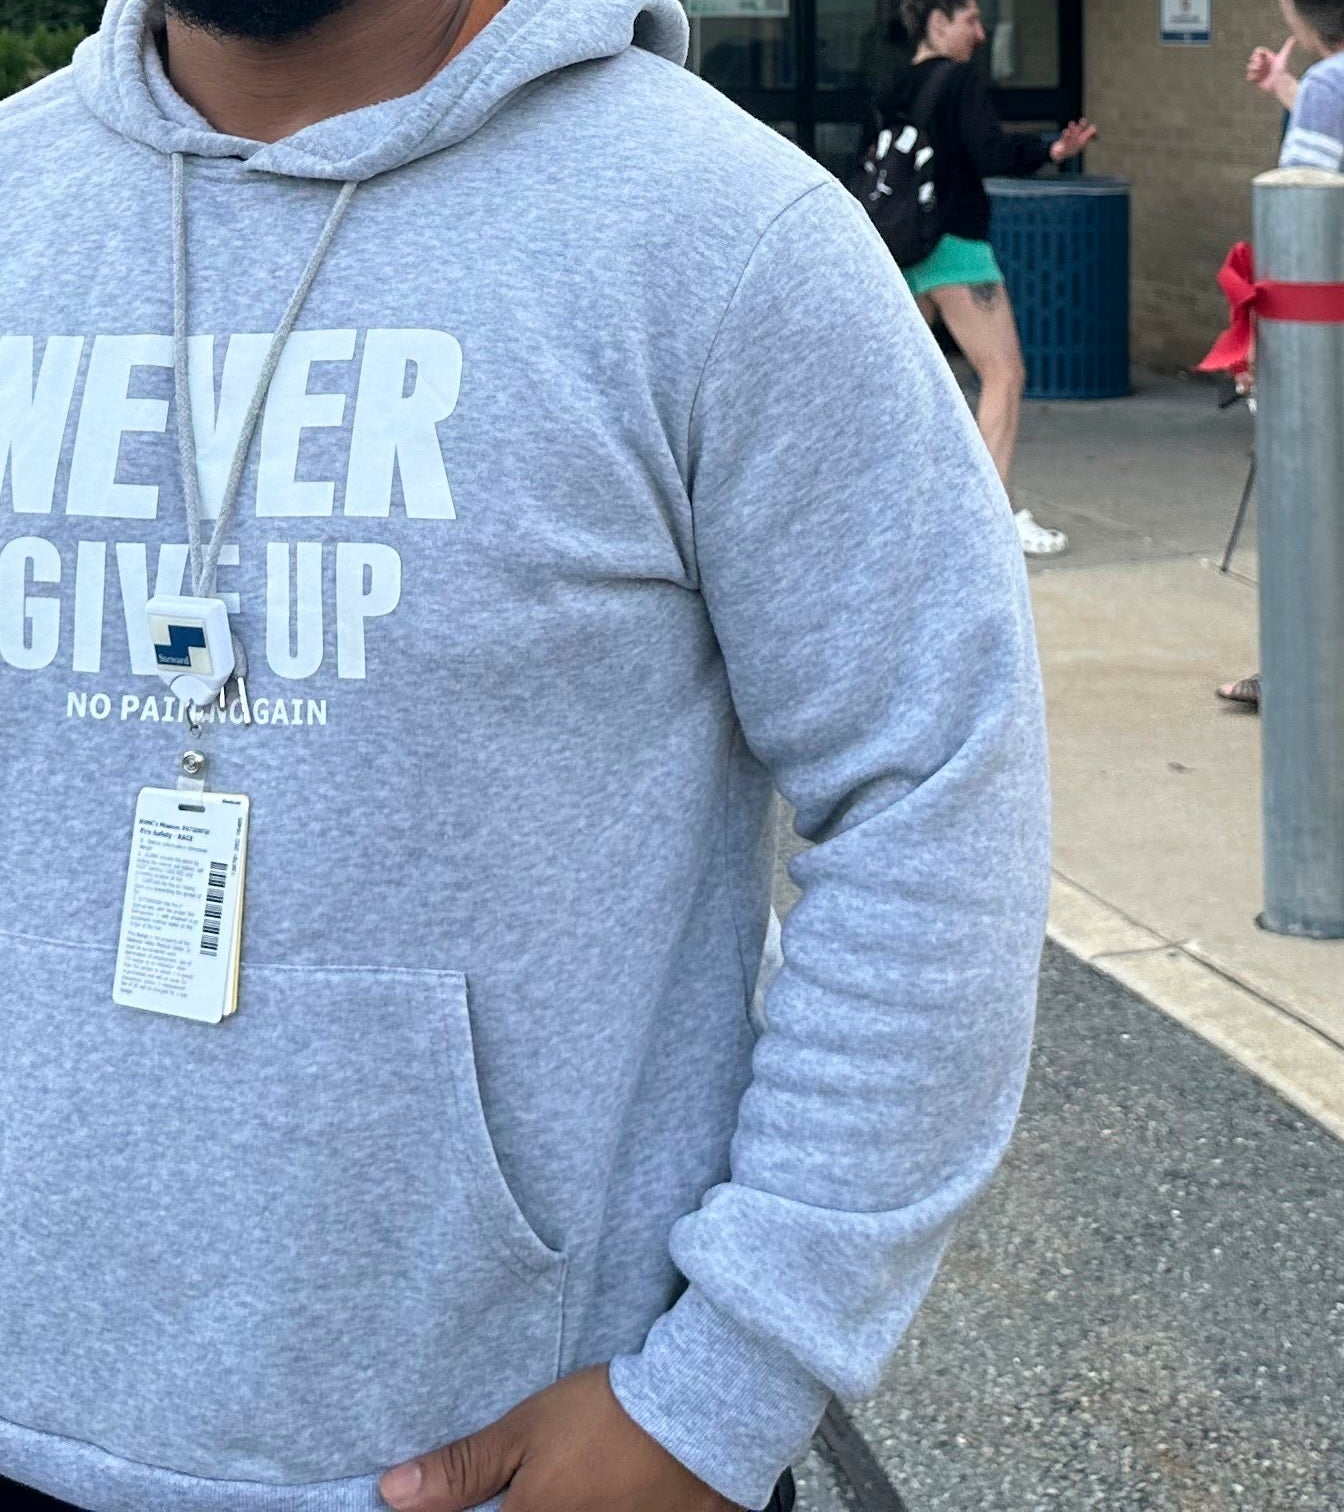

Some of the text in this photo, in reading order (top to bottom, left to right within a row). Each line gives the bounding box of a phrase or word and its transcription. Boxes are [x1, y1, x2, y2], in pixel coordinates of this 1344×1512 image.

[265, 542, 402, 680] UP
[66, 691, 112, 720] NO
[252, 697, 327, 726] GAIN
